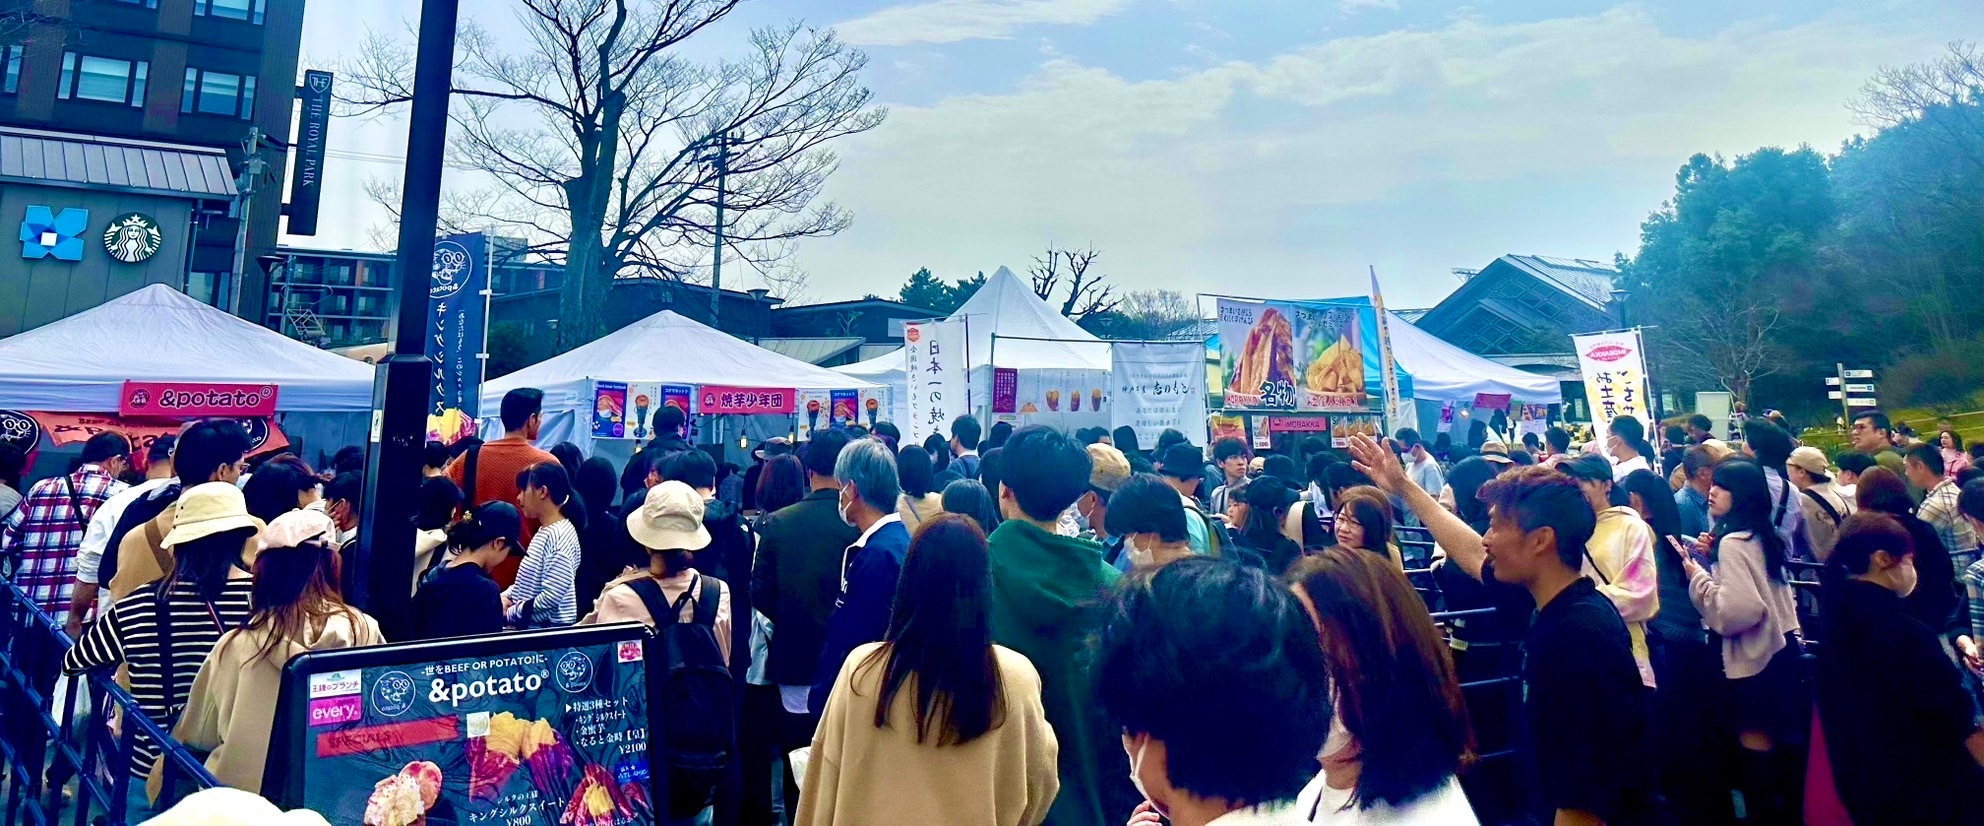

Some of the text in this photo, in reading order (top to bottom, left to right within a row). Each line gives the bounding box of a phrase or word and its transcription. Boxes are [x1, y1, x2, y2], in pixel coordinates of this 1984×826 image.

[303, 96, 323, 187] THE ROYAL PARK
[720, 392, 784, 409] 焼芋少年団
[1259, 380, 1297, 406] 名物
[472, 661, 487, 670] OR
[312, 704, 358, 720] every.
[468, 797, 565, 823] キングシルクスイート
